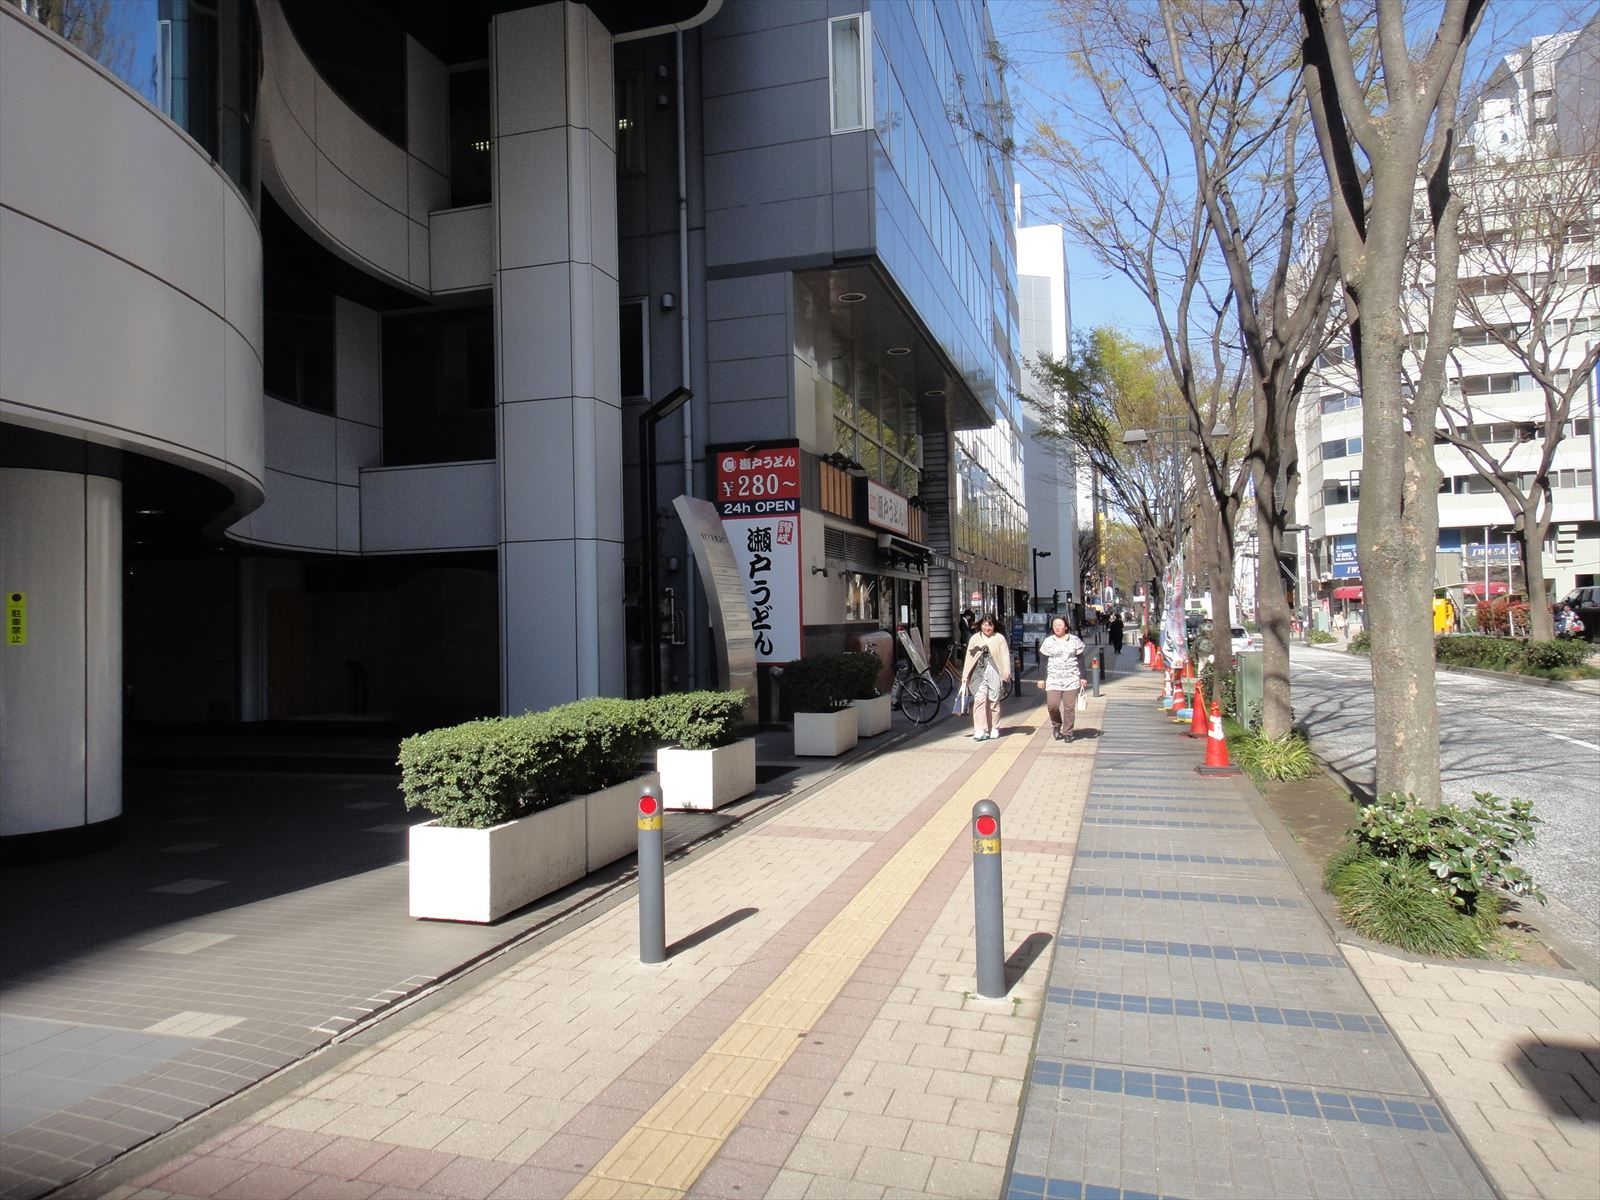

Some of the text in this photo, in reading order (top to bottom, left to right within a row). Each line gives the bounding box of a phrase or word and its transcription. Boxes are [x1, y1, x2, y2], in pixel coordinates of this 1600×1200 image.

[739, 455, 796, 471] 瀬戸うどん
[723, 500, 795, 515] 24h OPEN
[747, 526, 773, 655] 瀬戸うどん
